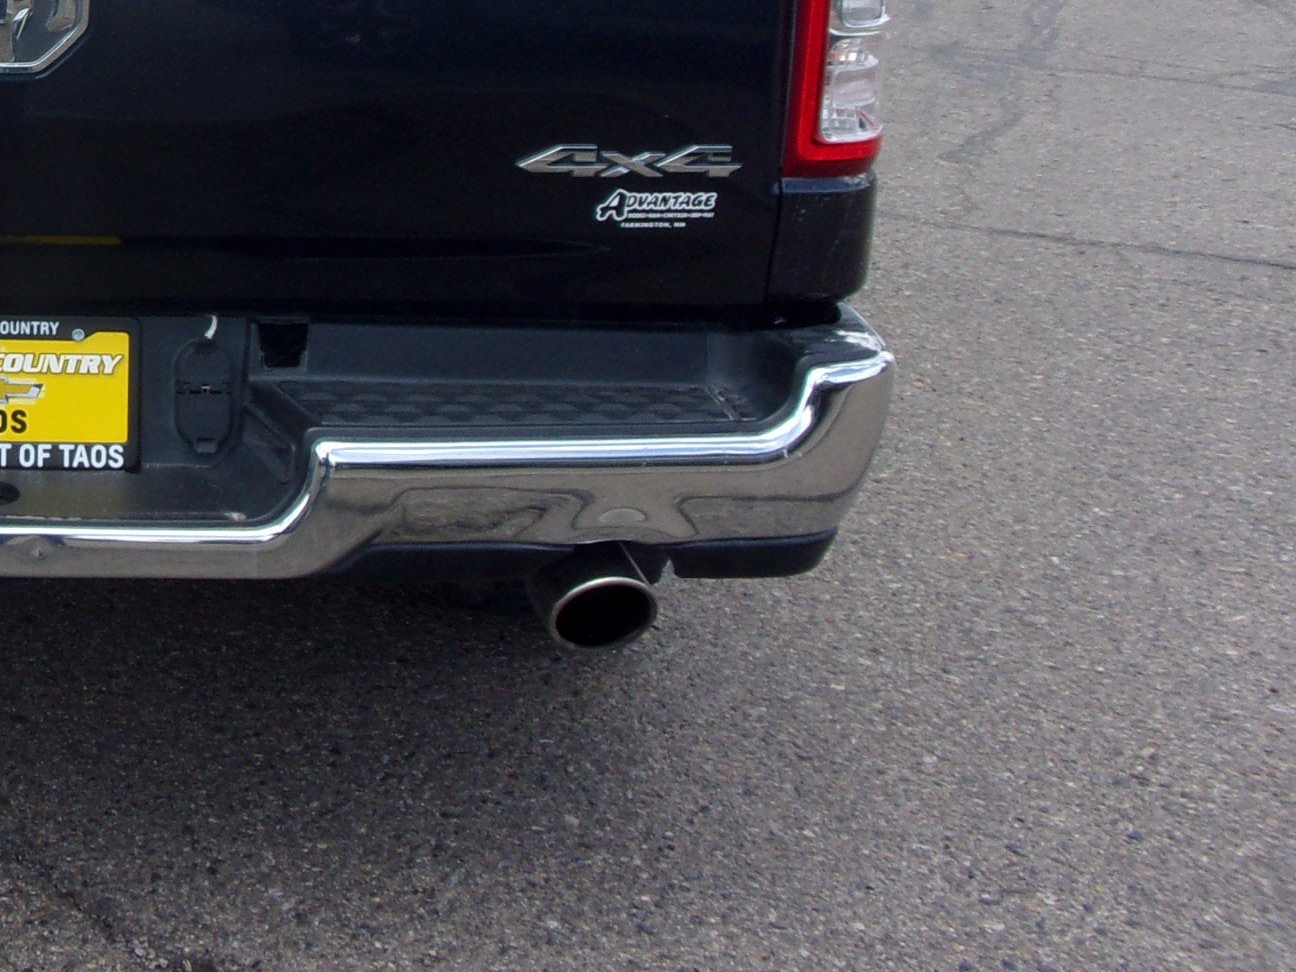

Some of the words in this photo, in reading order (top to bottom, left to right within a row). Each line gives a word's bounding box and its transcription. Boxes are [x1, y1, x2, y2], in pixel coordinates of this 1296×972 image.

[596, 188, 718, 221] ADVANTAGE
[18, 444, 52, 468] OF
[58, 444, 124, 469] TAOS
